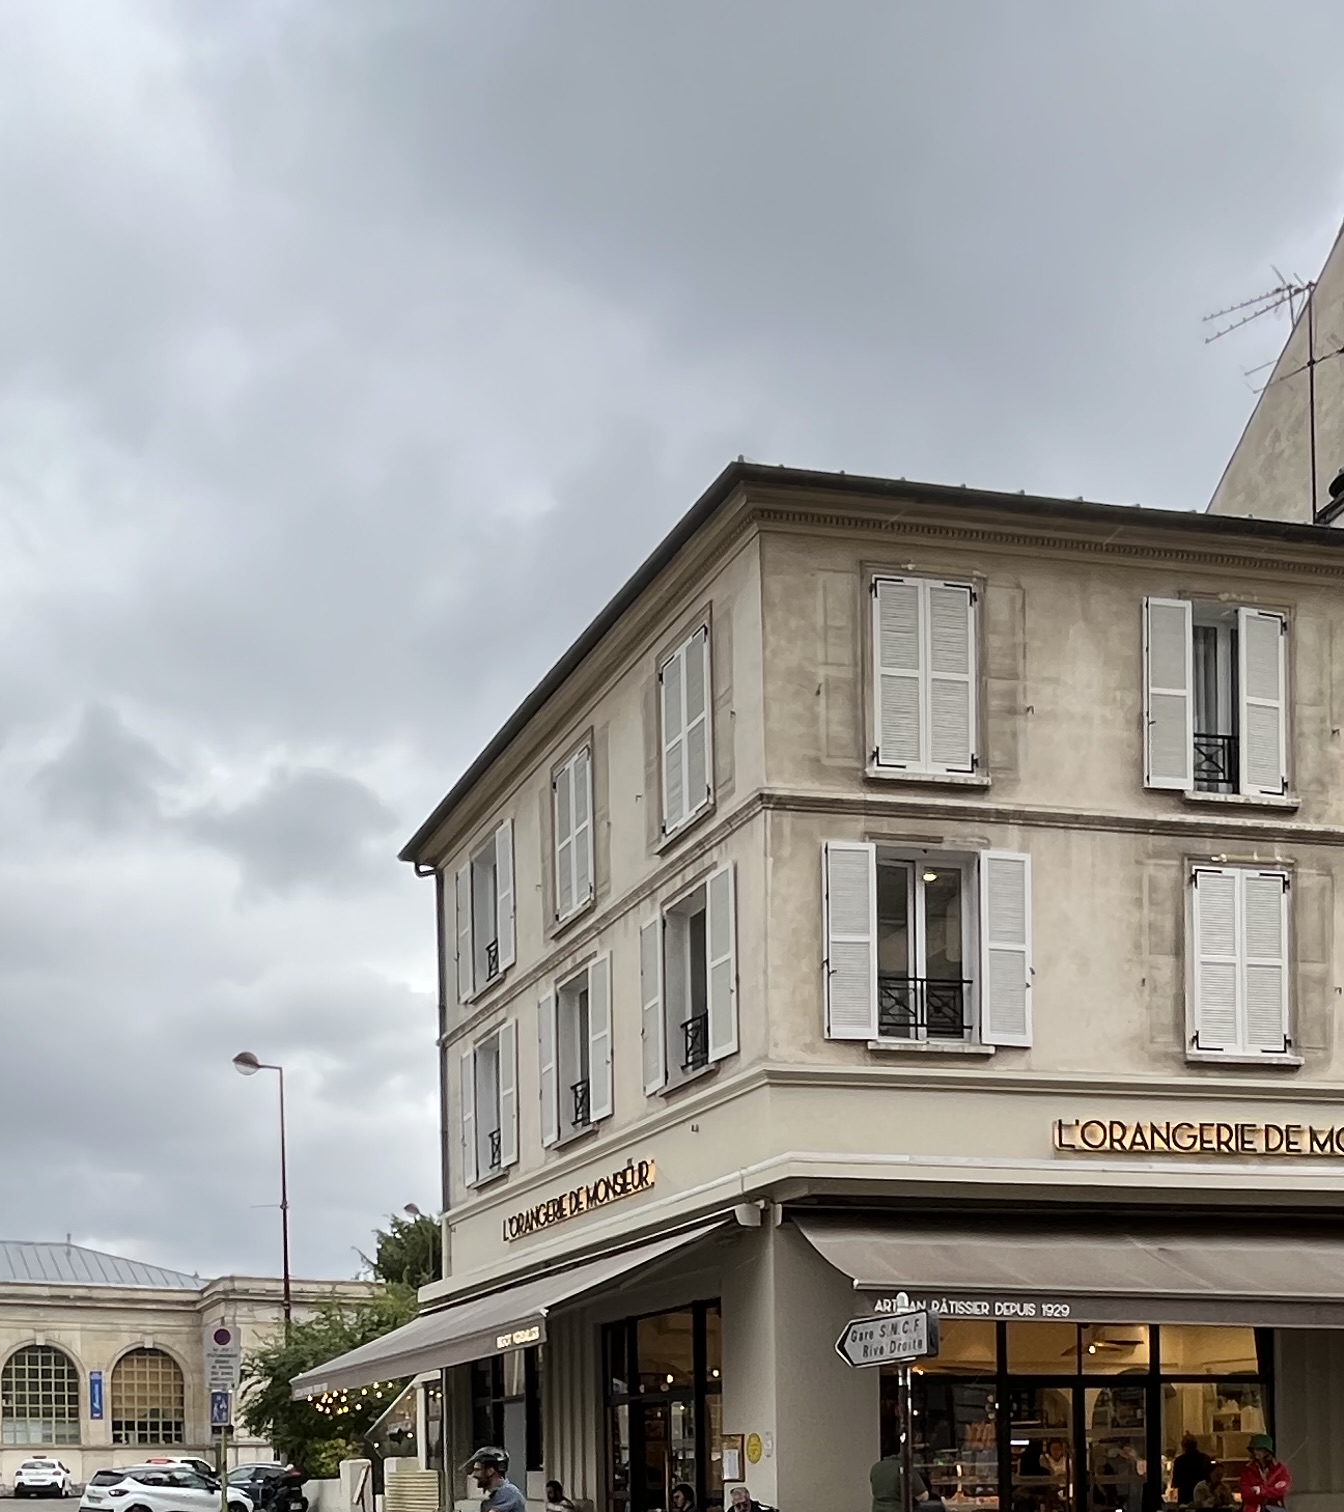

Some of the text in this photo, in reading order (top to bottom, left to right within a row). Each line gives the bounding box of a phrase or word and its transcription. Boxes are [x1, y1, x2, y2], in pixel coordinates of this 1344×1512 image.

[1058, 1119, 1257, 1153] L'ORANGERIE
[1264, 1124, 1301, 1153] DE
[569, 1186, 585, 1215] DE
[874, 1298, 926, 1312] ARTAN
[994, 1302, 1036, 1317] DEPUIS
[1041, 1303, 1070, 1318] 1929
[850, 1328, 874, 1343] Gare
[862, 1337, 923, 1358] Rive Droite
